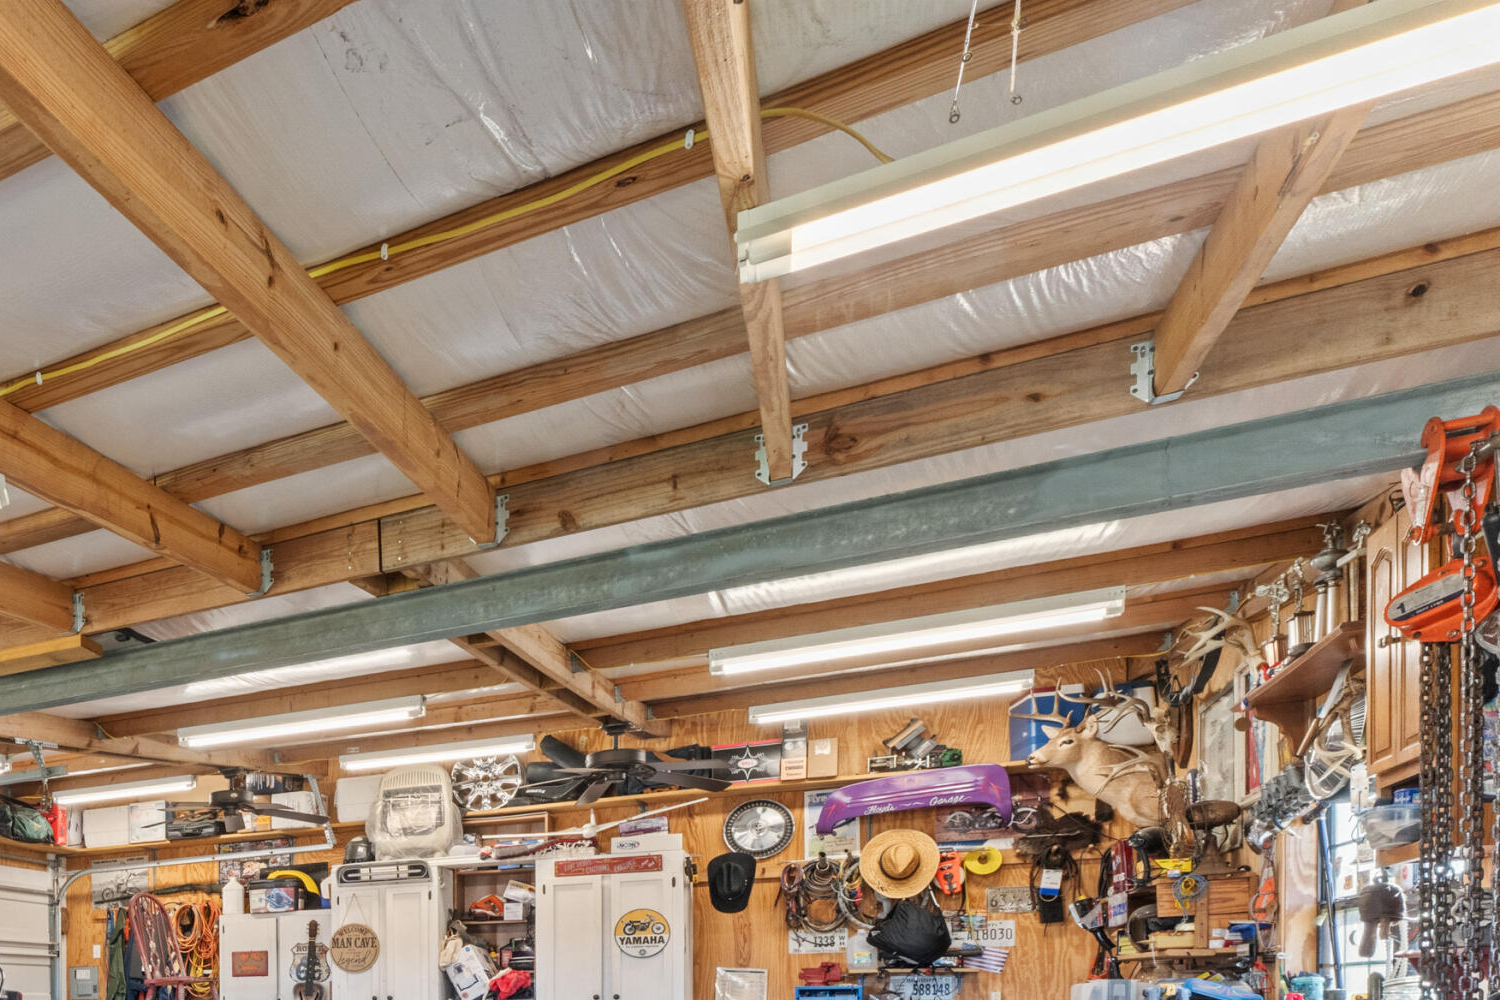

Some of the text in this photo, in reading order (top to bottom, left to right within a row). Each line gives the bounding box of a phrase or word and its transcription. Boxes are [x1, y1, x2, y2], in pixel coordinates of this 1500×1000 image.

[929, 795, 967, 806] Garage
[332, 936, 377, 949] MAN CAVE
[619, 936, 665, 945] YAMAHA
